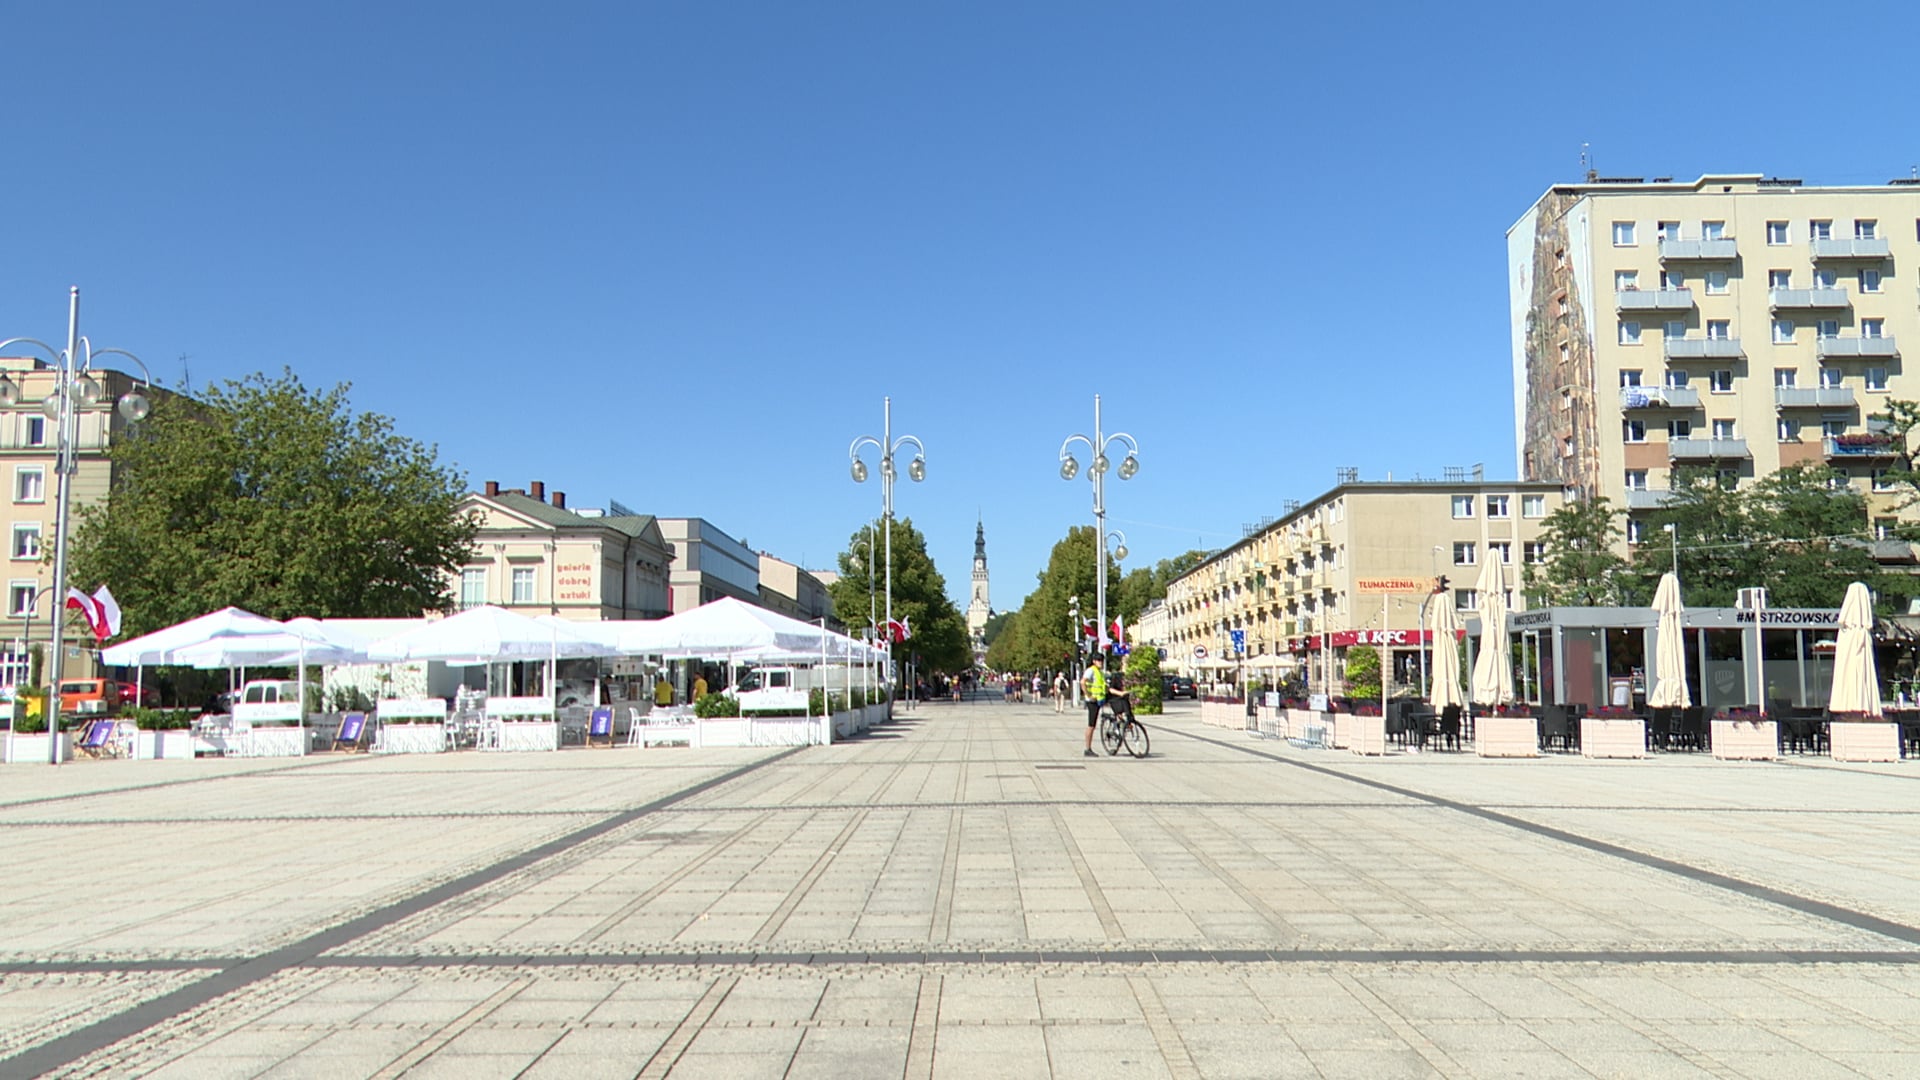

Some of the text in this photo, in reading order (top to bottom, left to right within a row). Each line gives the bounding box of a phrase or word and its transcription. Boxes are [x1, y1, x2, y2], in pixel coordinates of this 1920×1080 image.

[558, 577, 591, 587] dobrej
[560, 590, 591, 600] sztuki
[1736, 612, 1840, 624] #MSTRZOWSKA
[1371, 630, 1407, 643] KFC
